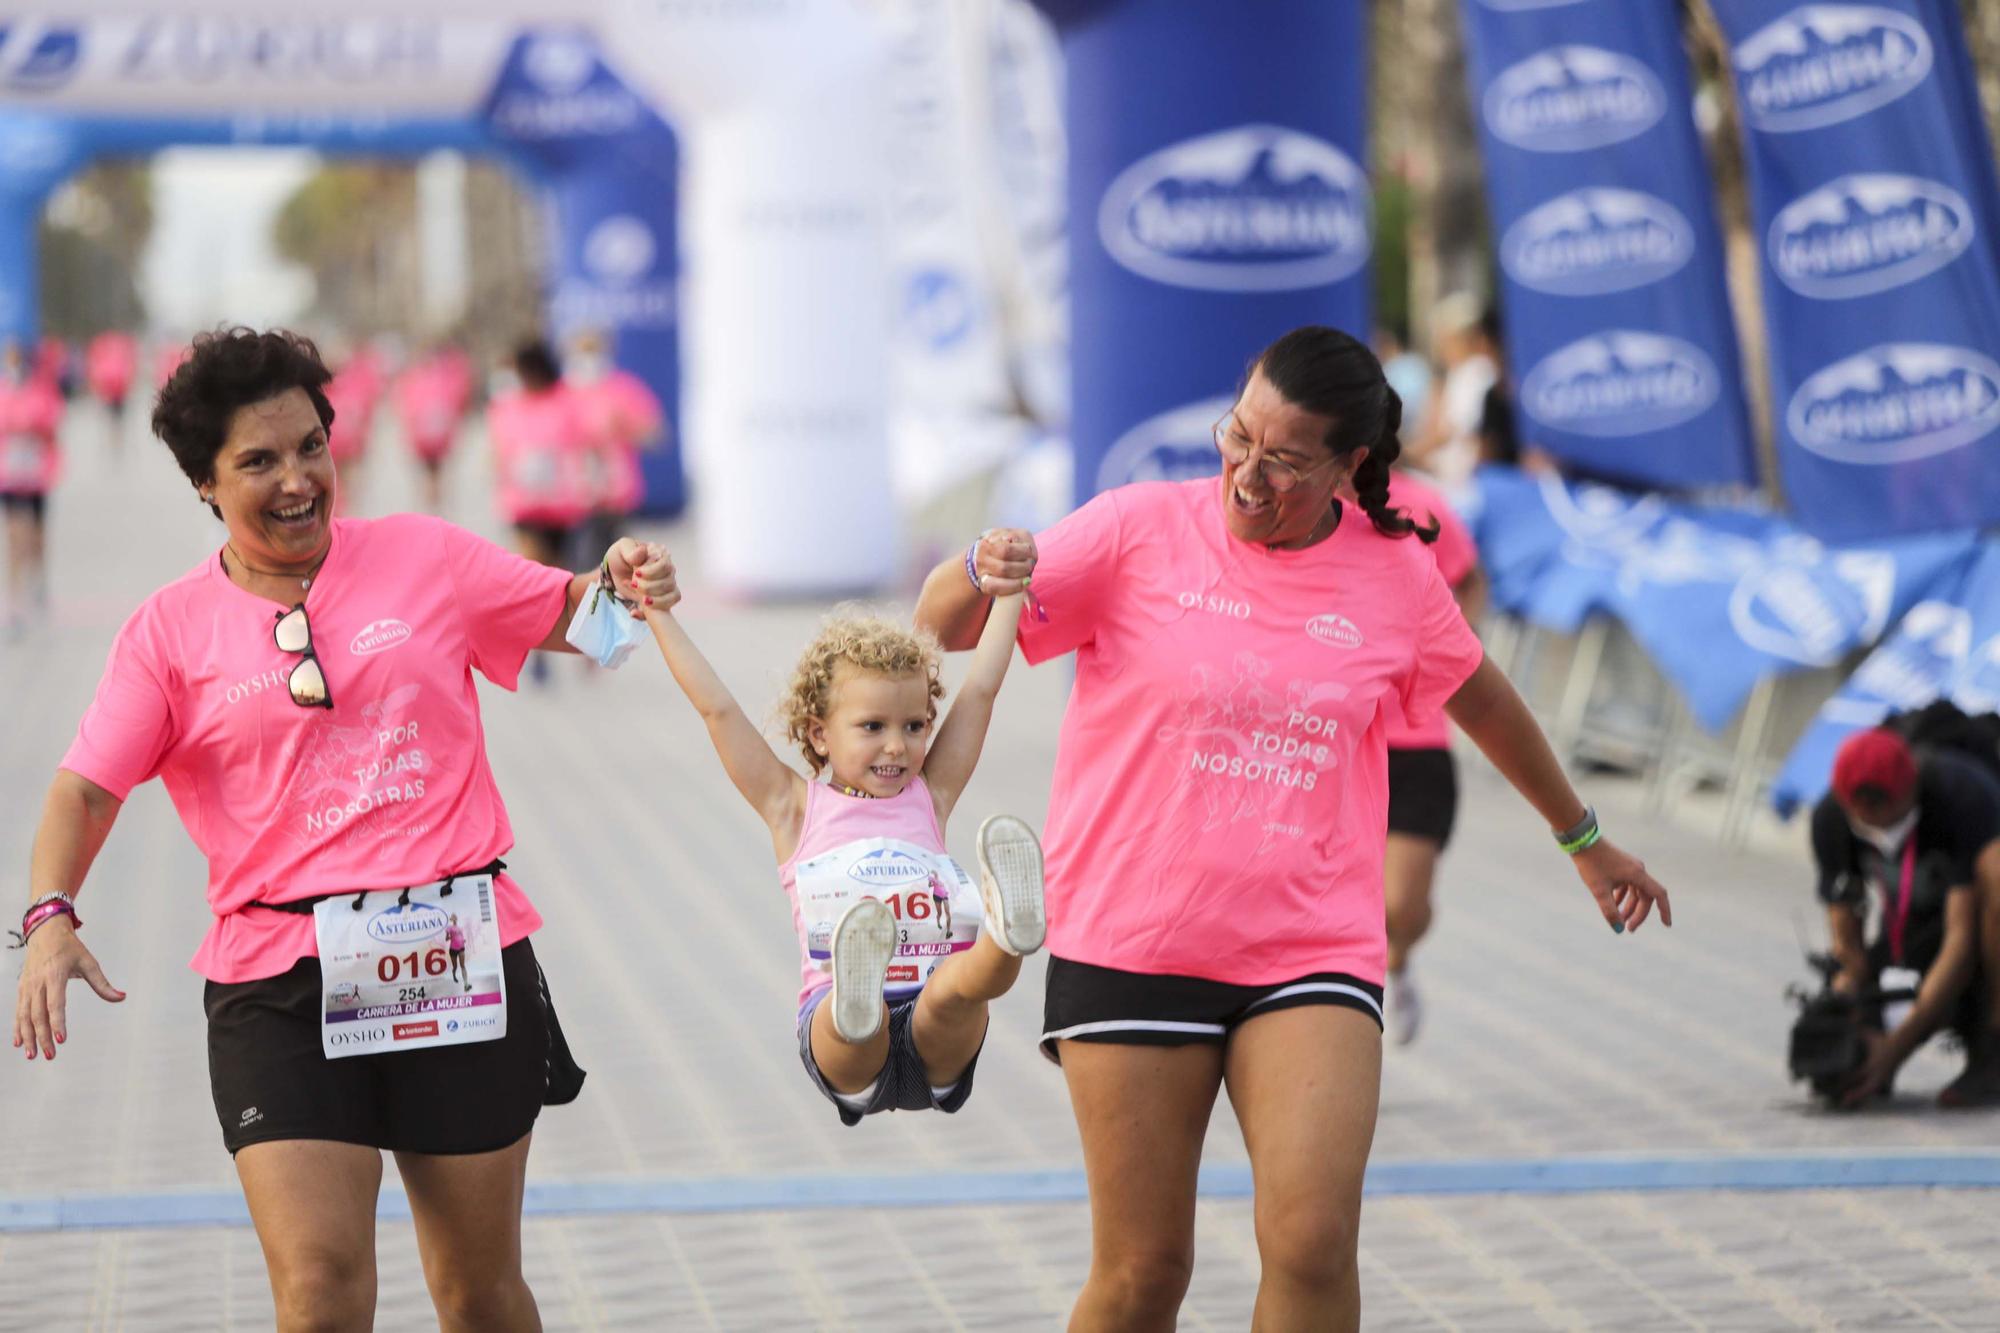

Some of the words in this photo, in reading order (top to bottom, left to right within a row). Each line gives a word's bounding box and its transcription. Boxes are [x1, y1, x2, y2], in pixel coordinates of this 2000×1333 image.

[1178, 591, 1250, 620] OYSHO
[354, 627, 409, 652] ASTURIANA
[377, 721, 419, 750] POR
[1288, 711, 1338, 740] POR
[1250, 730, 1329, 764] TODAS
[353, 750, 424, 787] TODAS
[1190, 751, 1317, 791] NOSOTRAS
[306, 779, 425, 832] NOSOTRAS
[854, 864, 926, 877] ASTURIANA
[860, 891, 931, 921] 16
[375, 917, 443, 936] ASTURIANA
[903, 944, 916, 956] LA
[918, 944, 952, 956] MUJER
[377, 948, 448, 982] 016
[356, 1005, 403, 1020] CARRERA
[404, 1002, 419, 1013] DE
[420, 1000, 435, 1012] LA
[436, 996, 473, 1010] MUJER
[398, 986, 426, 1002] 254
[330, 1028, 385, 1045] OYSHO
